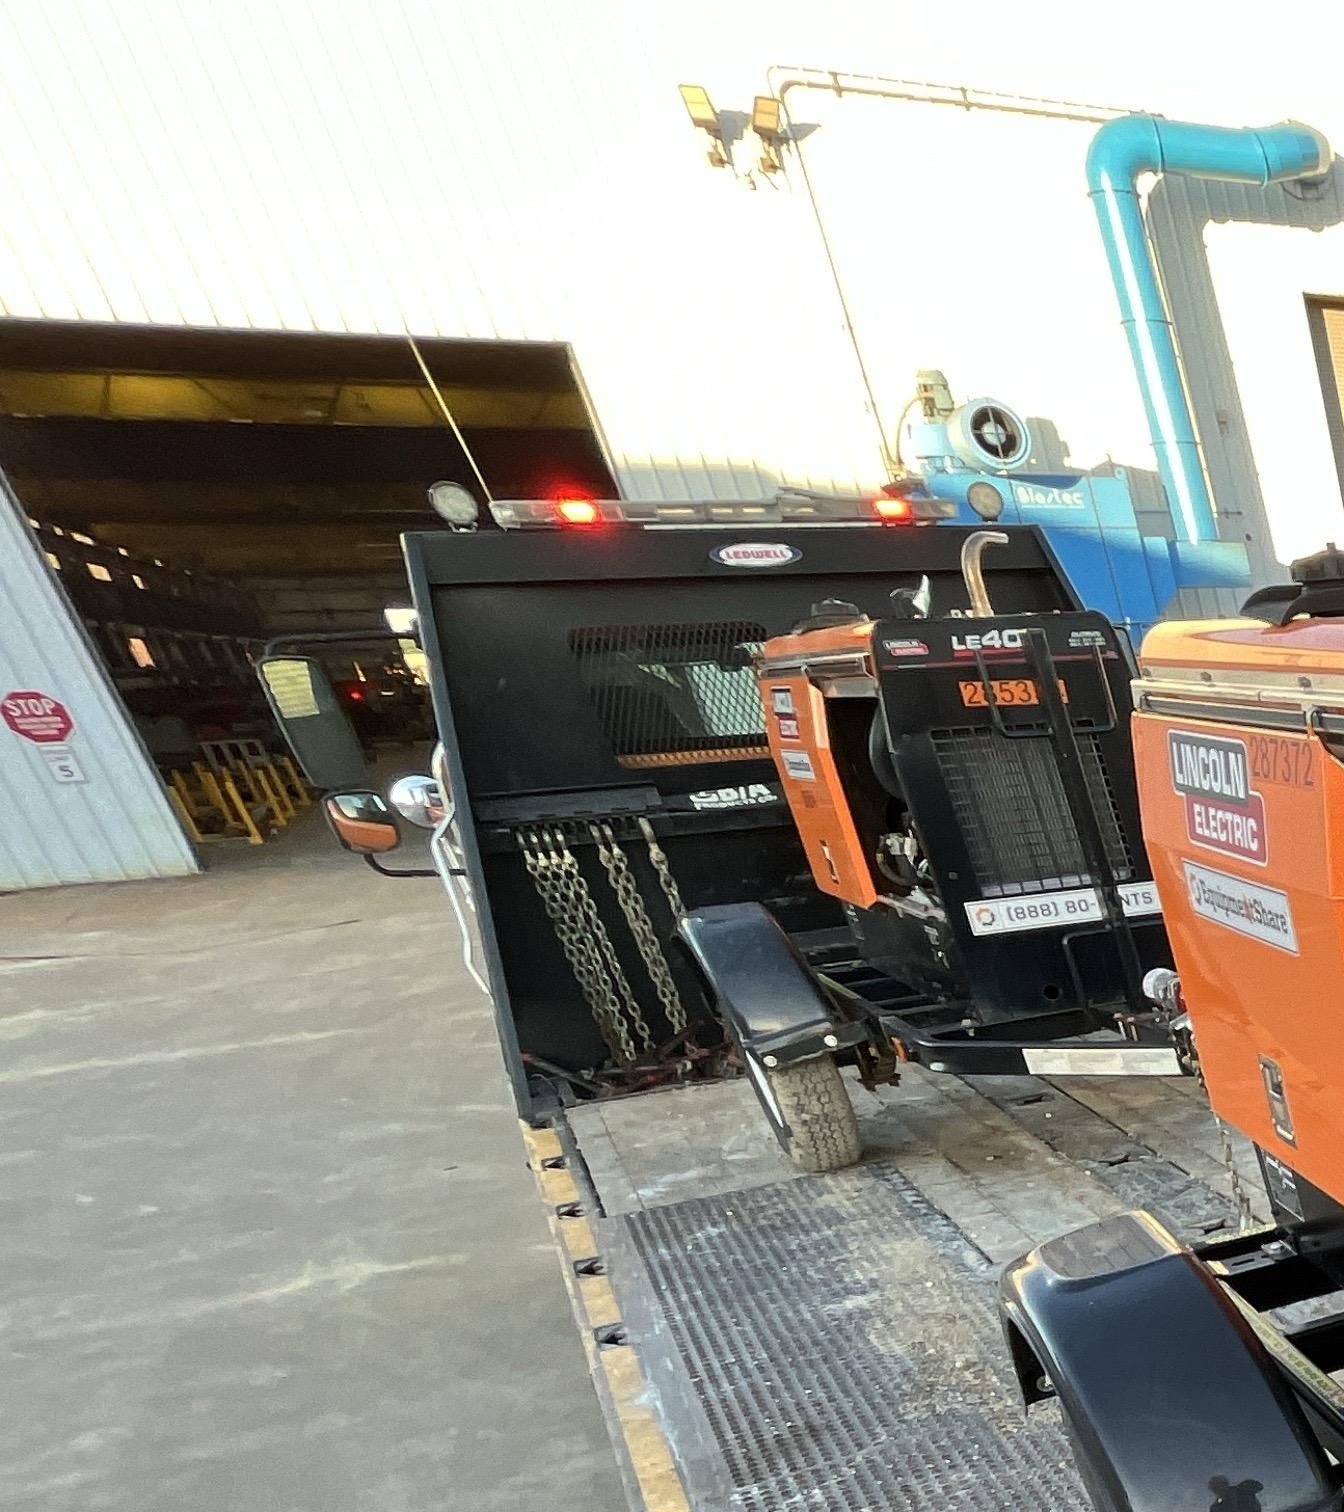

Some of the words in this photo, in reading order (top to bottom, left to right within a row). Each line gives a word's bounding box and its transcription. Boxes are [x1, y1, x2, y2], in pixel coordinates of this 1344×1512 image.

[725, 549, 787, 561] LEDWELL
[951, 628, 1027, 650] LE40
[4, 698, 56, 717] STOP
[1172, 742, 1246, 800] LINCOLN
[1250, 736, 1315, 787] 287372
[1192, 803, 1259, 852] ELECTRIC
[1006, 900, 1059, 922] (888)
[1199, 878, 1289, 935] EquipmentShare
